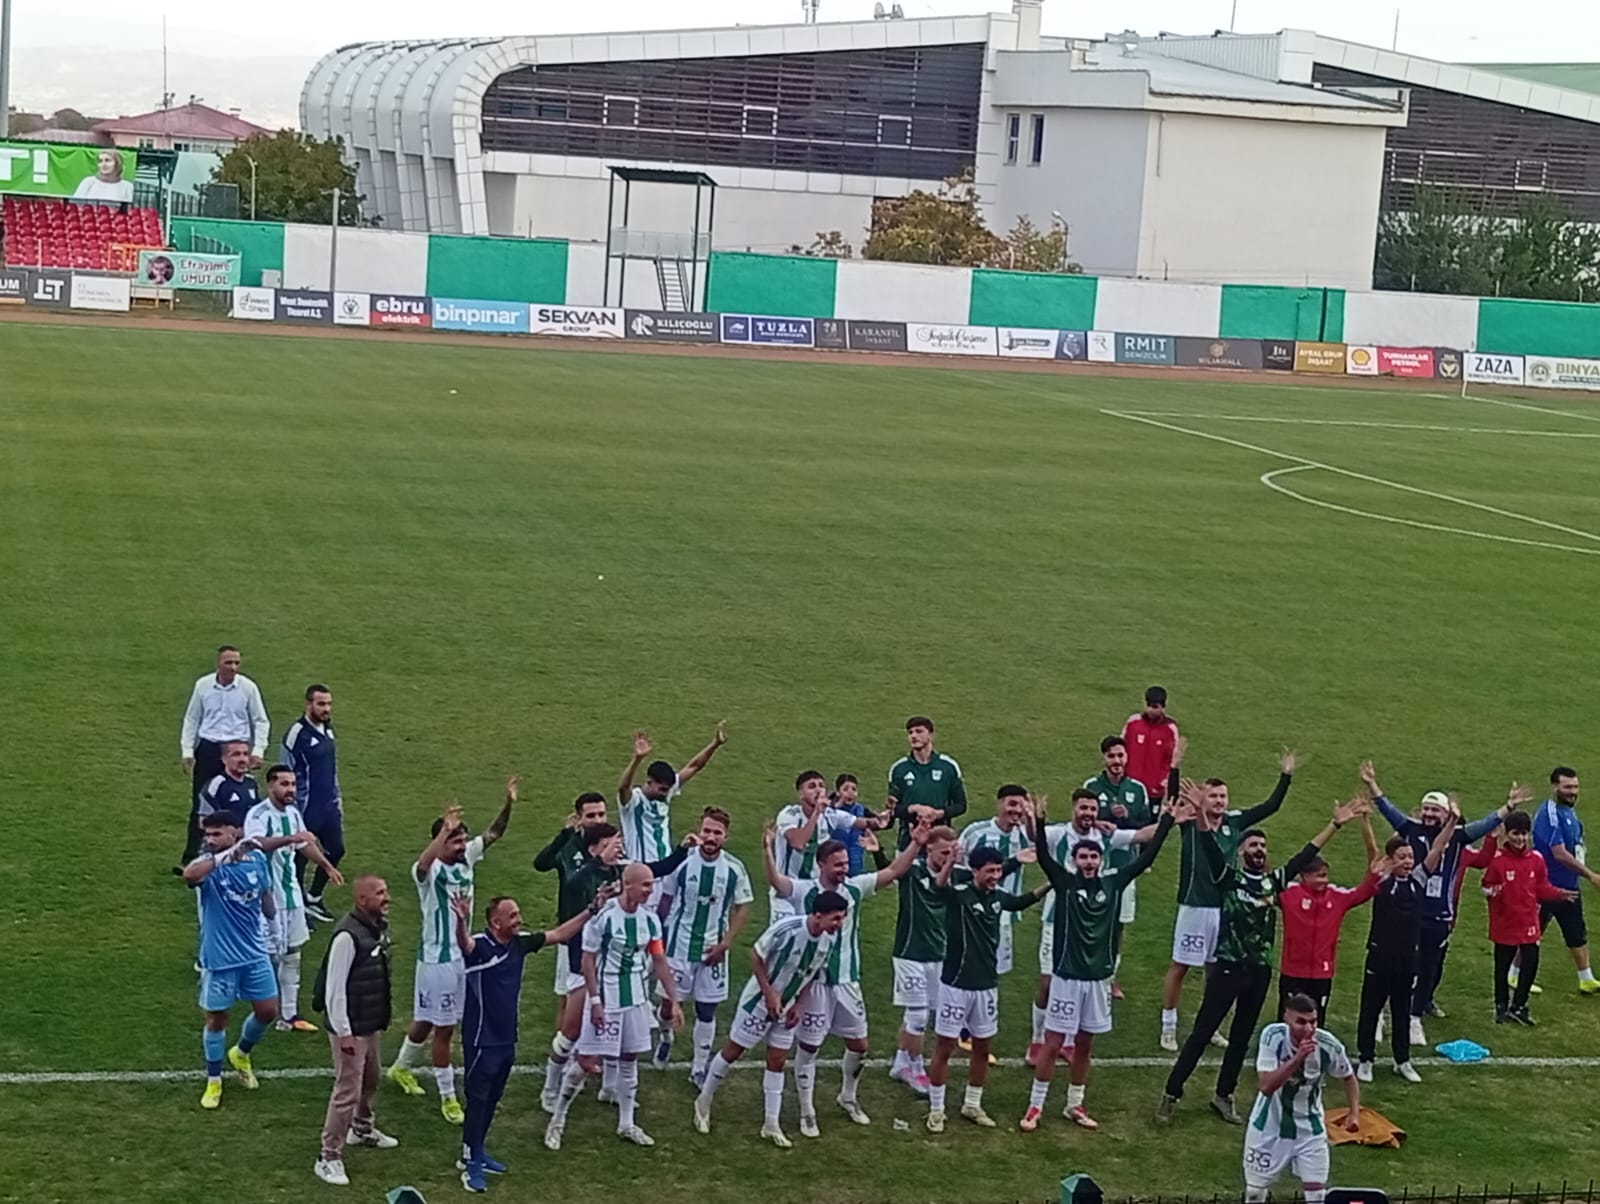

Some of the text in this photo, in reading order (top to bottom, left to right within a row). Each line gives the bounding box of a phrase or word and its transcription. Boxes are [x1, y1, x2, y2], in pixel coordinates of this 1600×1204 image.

[376, 296, 424, 314] ebru
[381, 314, 421, 324] elektrik
[538, 308, 616, 326] SEKVAN
[756, 321, 808, 335] TUZLA
[1124, 336, 1167, 352] RMIT
[1475, 356, 1513, 374] ZAZA
